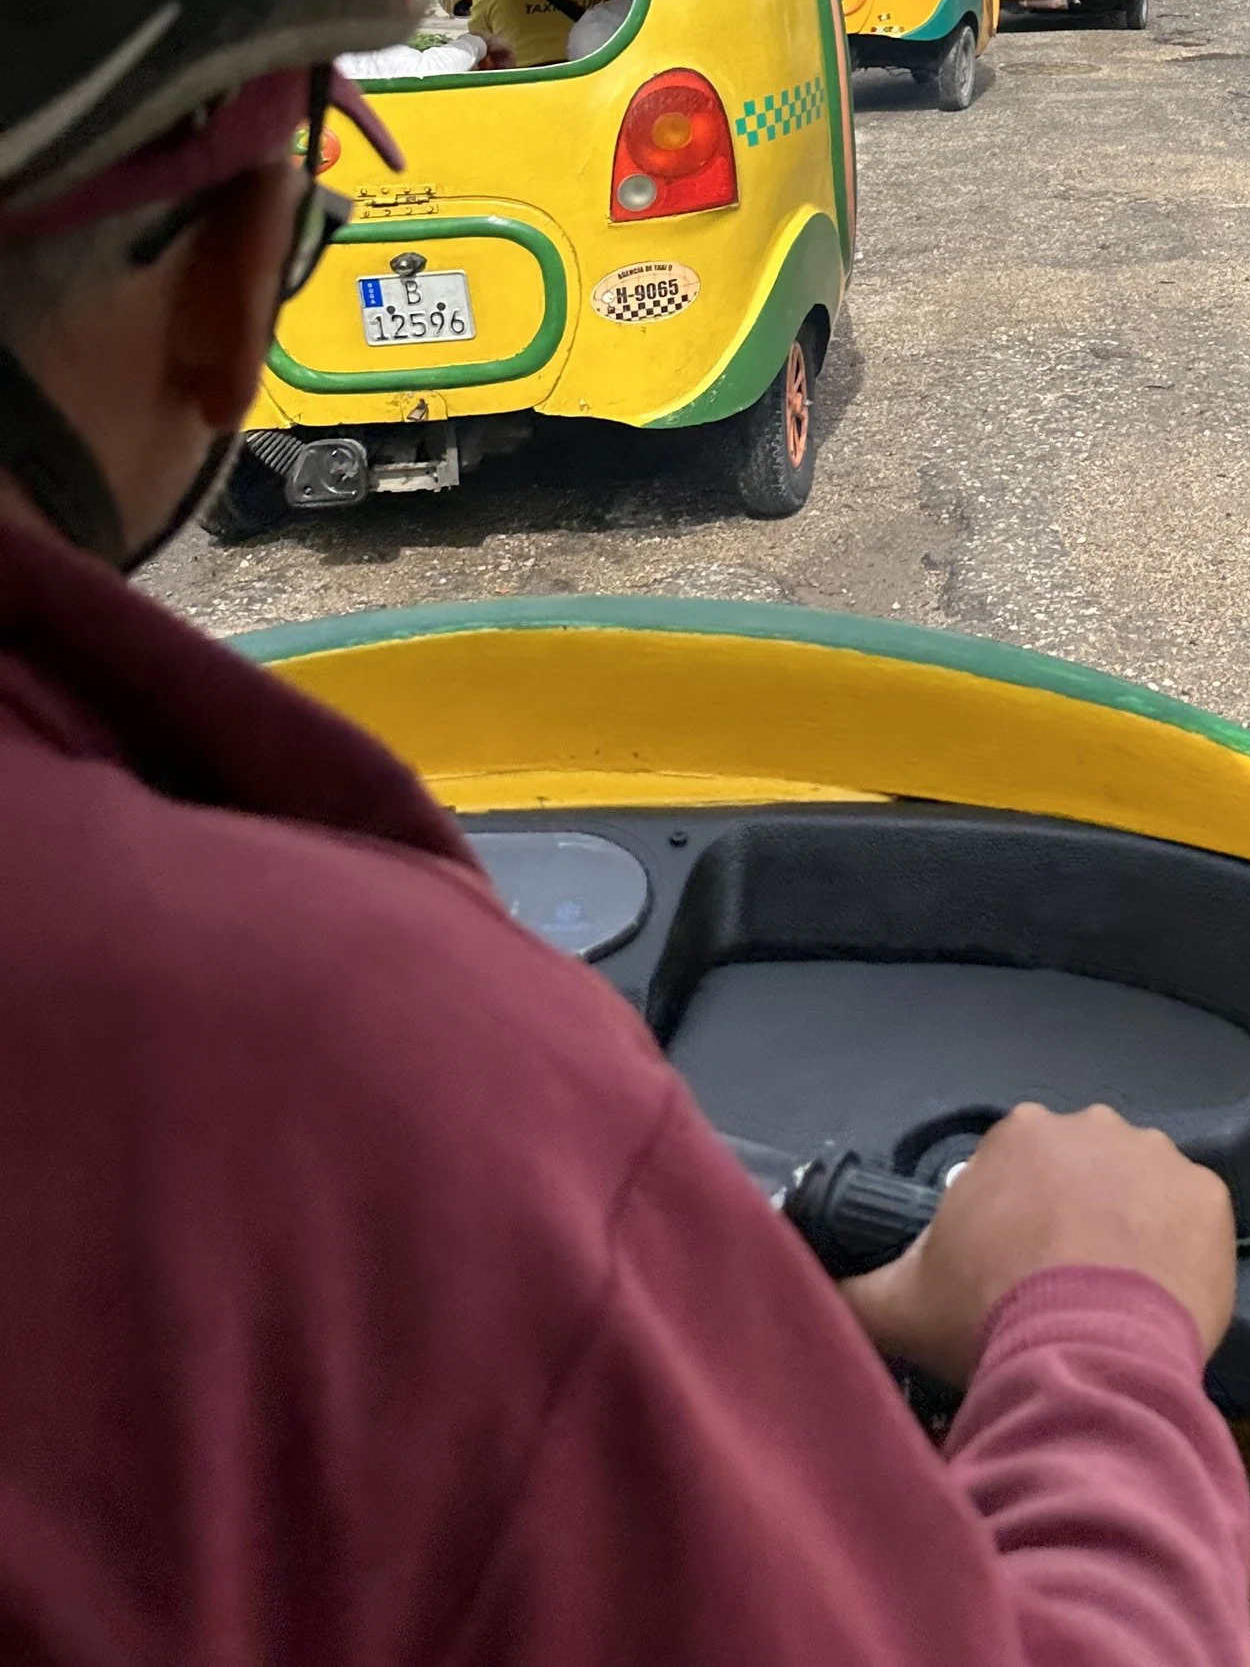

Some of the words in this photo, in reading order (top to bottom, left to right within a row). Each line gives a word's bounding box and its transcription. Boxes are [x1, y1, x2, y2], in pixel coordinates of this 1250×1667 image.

[405, 279, 422, 305] B
[616, 278, 679, 305] H-9065
[372, 309, 466, 341] 12596
